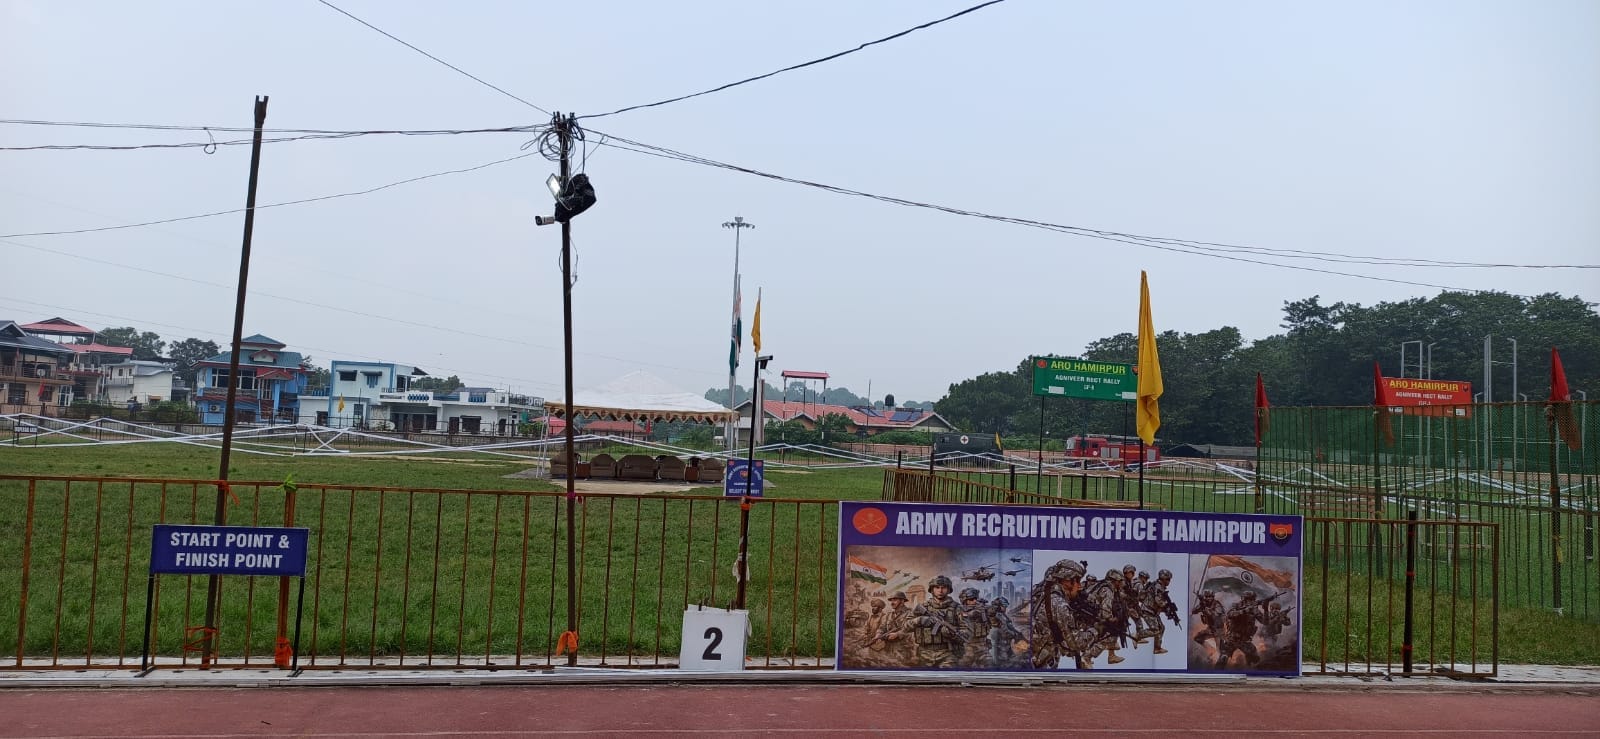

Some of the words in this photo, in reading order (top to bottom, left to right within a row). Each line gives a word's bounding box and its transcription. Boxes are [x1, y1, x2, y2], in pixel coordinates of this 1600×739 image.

[1051, 361, 1071, 370] ARO
[1074, 362, 1126, 374] HAMIRPUR
[1390, 380, 1408, 388] ARO
[1411, 381, 1459, 391] HAMIRPUR
[896, 512, 957, 536] ARMY
[962, 513, 1086, 540] RECRUITING
[1090, 516, 1157, 541] OFFICE
[1162, 518, 1266, 544] HAMIRPUR
[170, 532, 220, 546] START
[226, 534, 274, 548] POINT
[278, 534, 290, 548] &
[176, 552, 229, 568] FINISH
[234, 554, 283, 568] POINT
[702, 626, 722, 660] 2
